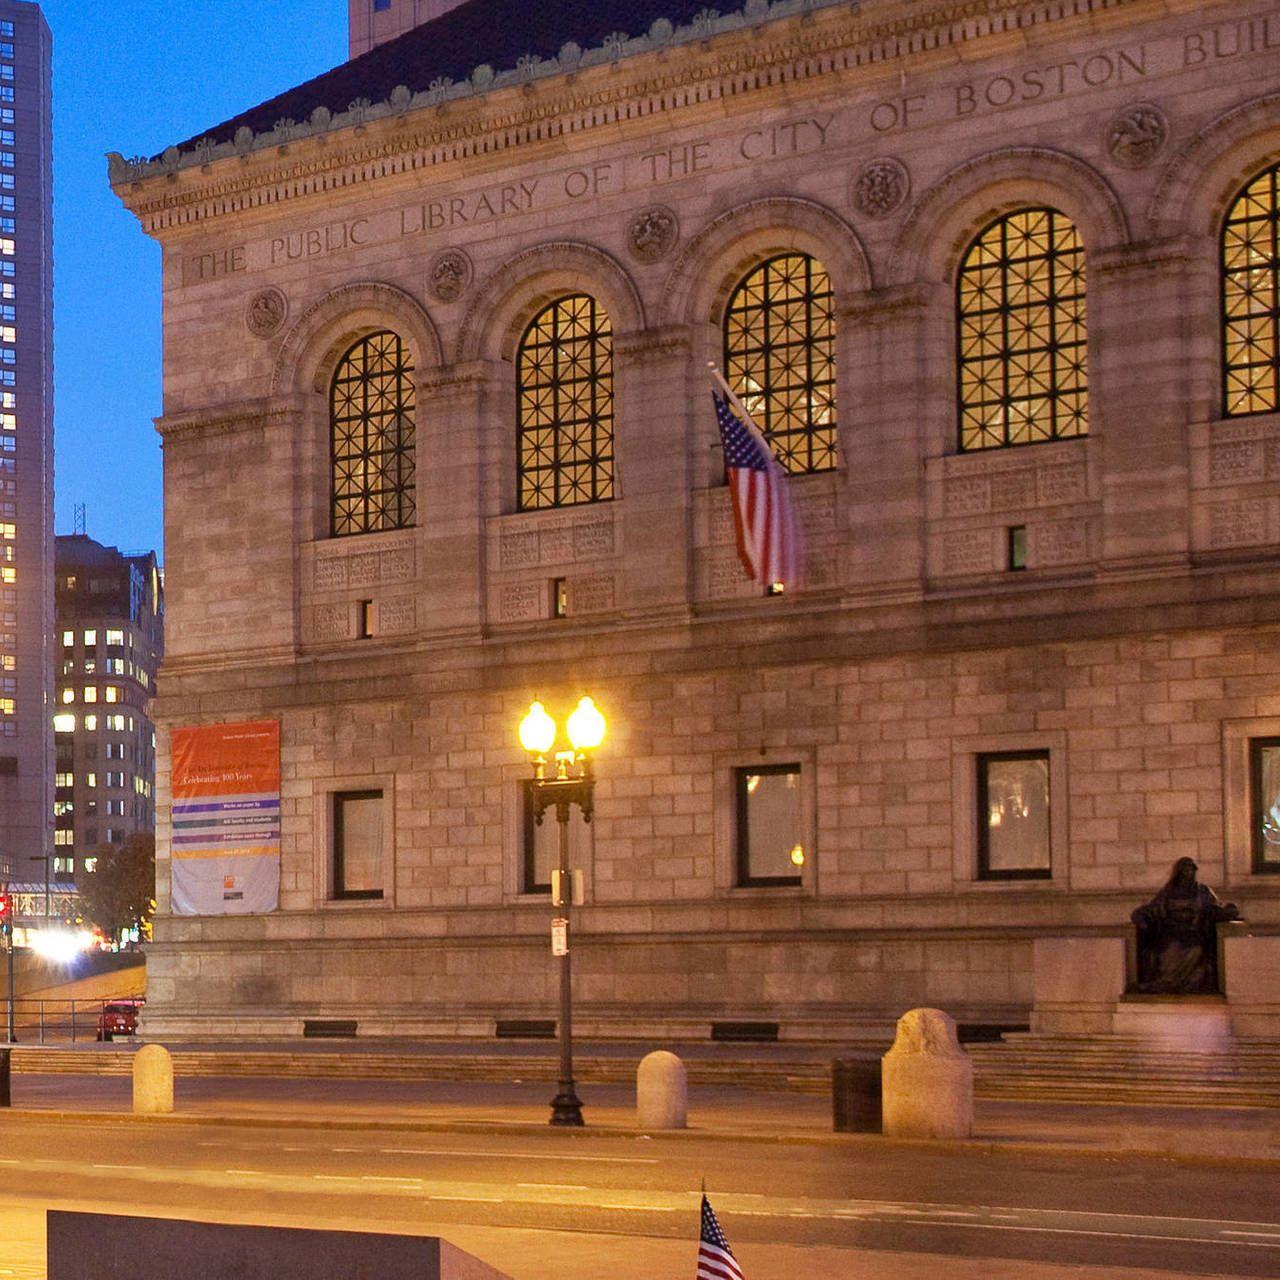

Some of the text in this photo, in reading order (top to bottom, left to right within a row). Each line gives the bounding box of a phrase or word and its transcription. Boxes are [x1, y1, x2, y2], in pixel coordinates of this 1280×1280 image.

[192, 246, 248, 278] THE
[270, 219, 369, 264] PUBLIC
[399, 180, 539, 236] LIBRARY
[564, 164, 612, 198] OF
[641, 142, 714, 181] THE
[740, 113, 834, 160] CITY
[871, 94, 926, 132] OF
[955, 45, 1146, 116] BOSTON
